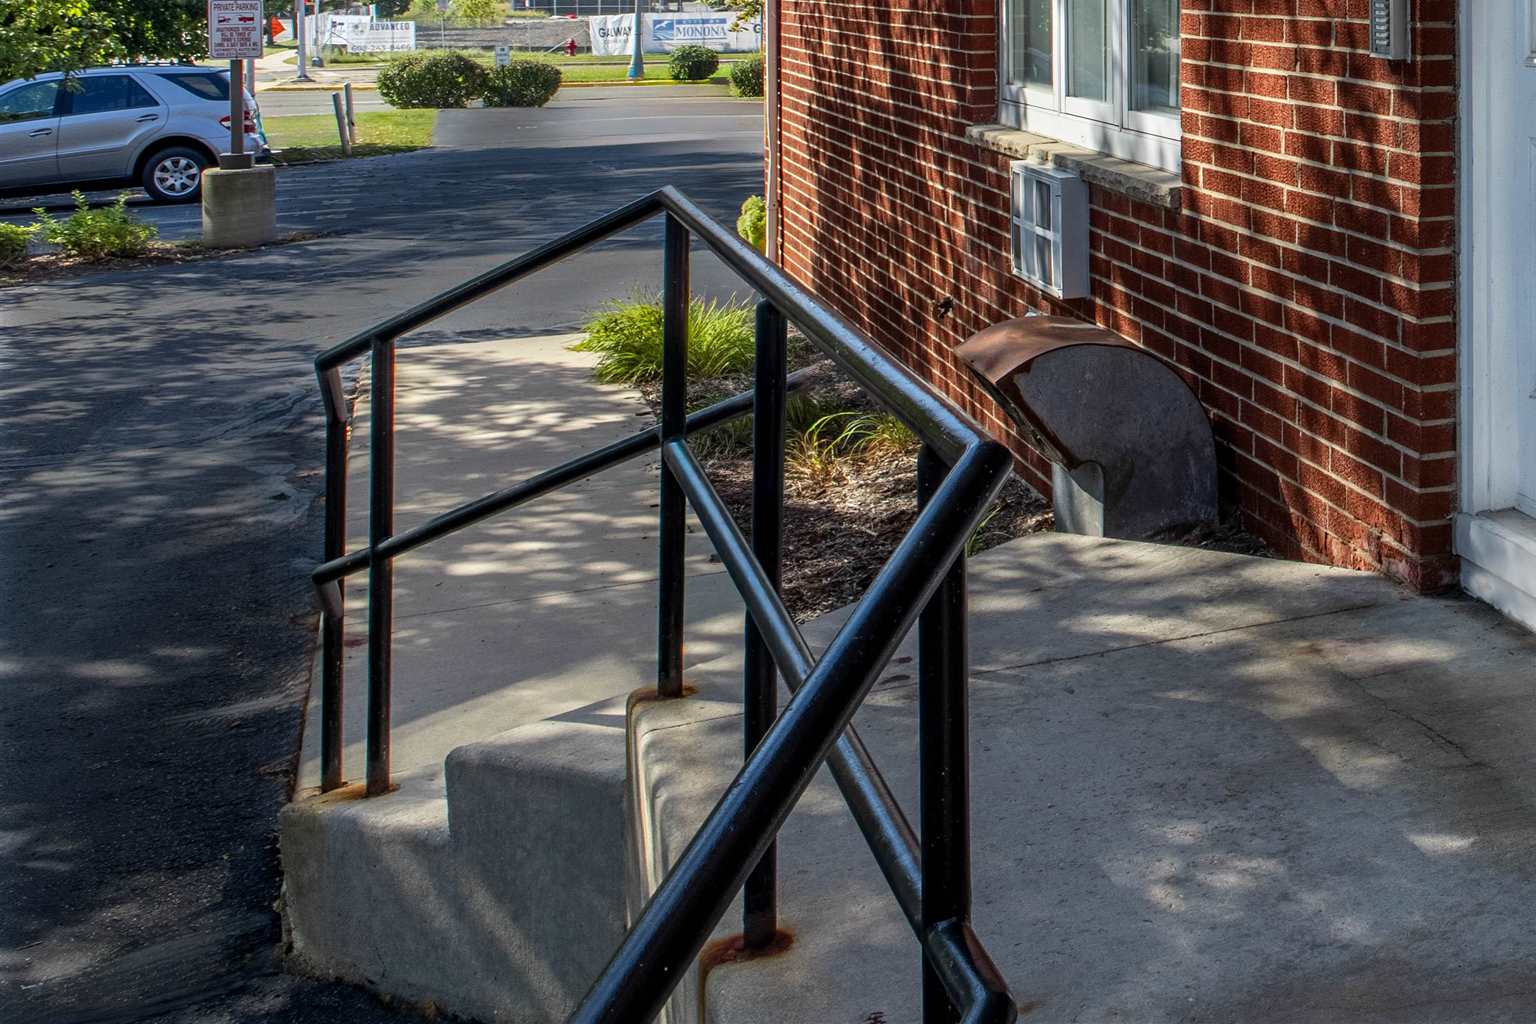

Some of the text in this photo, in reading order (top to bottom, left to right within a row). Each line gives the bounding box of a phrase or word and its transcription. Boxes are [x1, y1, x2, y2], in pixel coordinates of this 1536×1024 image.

[213, 2, 259, 12] PRIVATE PARKING
[369, 22, 410, 31] ADVANCED
[676, 24, 727, 37] MONONA
